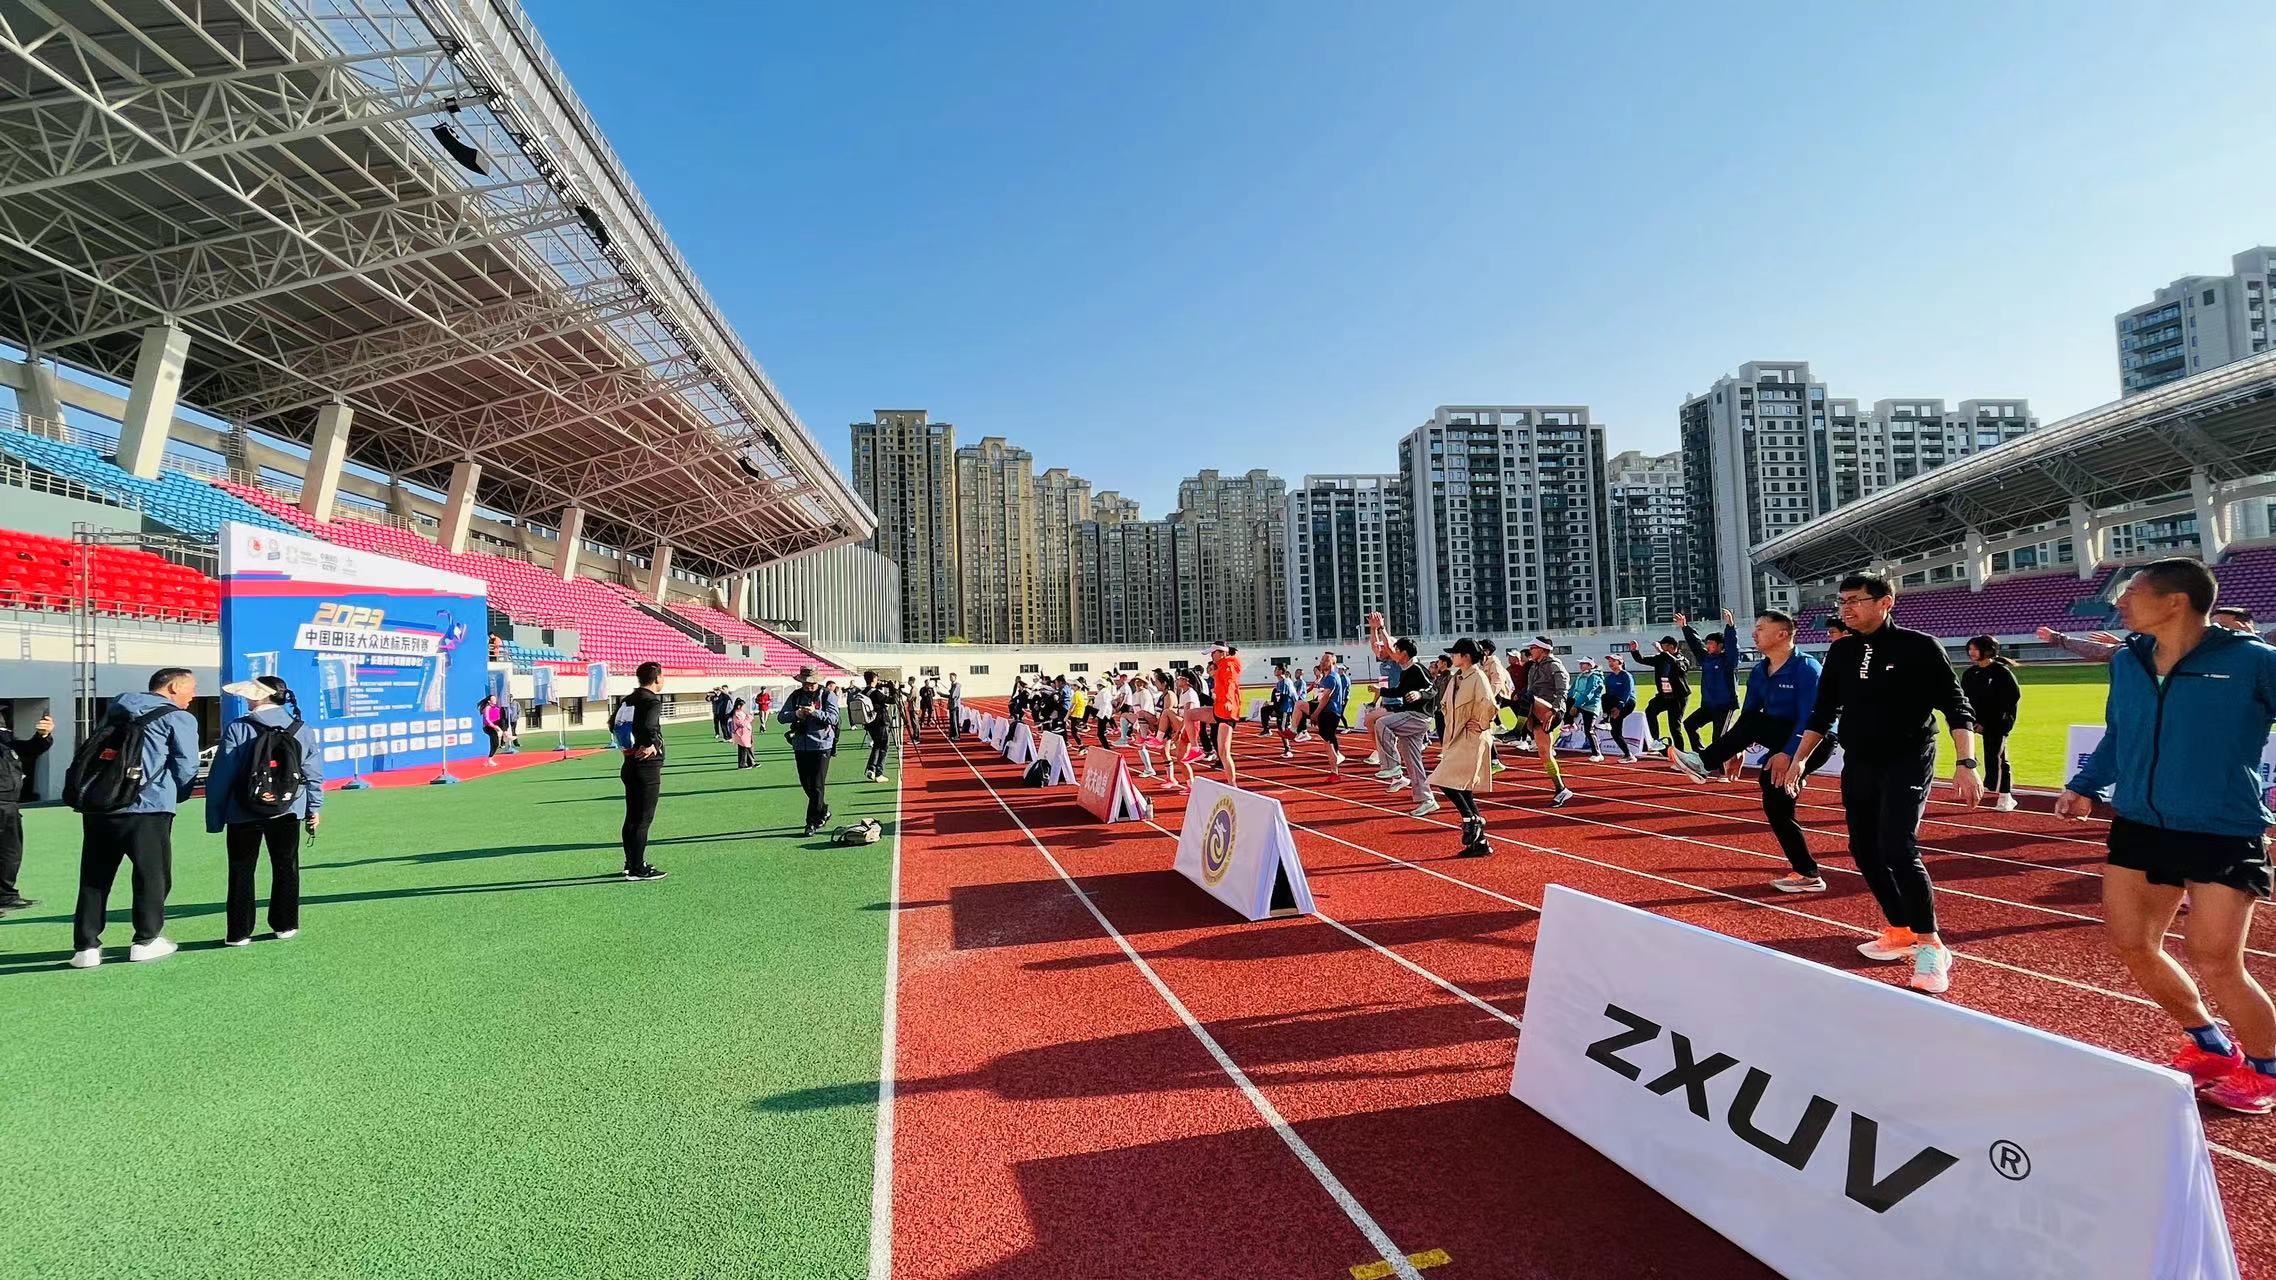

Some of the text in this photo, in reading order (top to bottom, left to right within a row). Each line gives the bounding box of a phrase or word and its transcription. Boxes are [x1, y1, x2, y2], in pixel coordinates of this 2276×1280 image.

[312, 602, 385, 630] 2023
[306, 629, 429, 652] 中国田径大众达标系列赛
[1585, 1003, 1960, 1214] ZXUV
